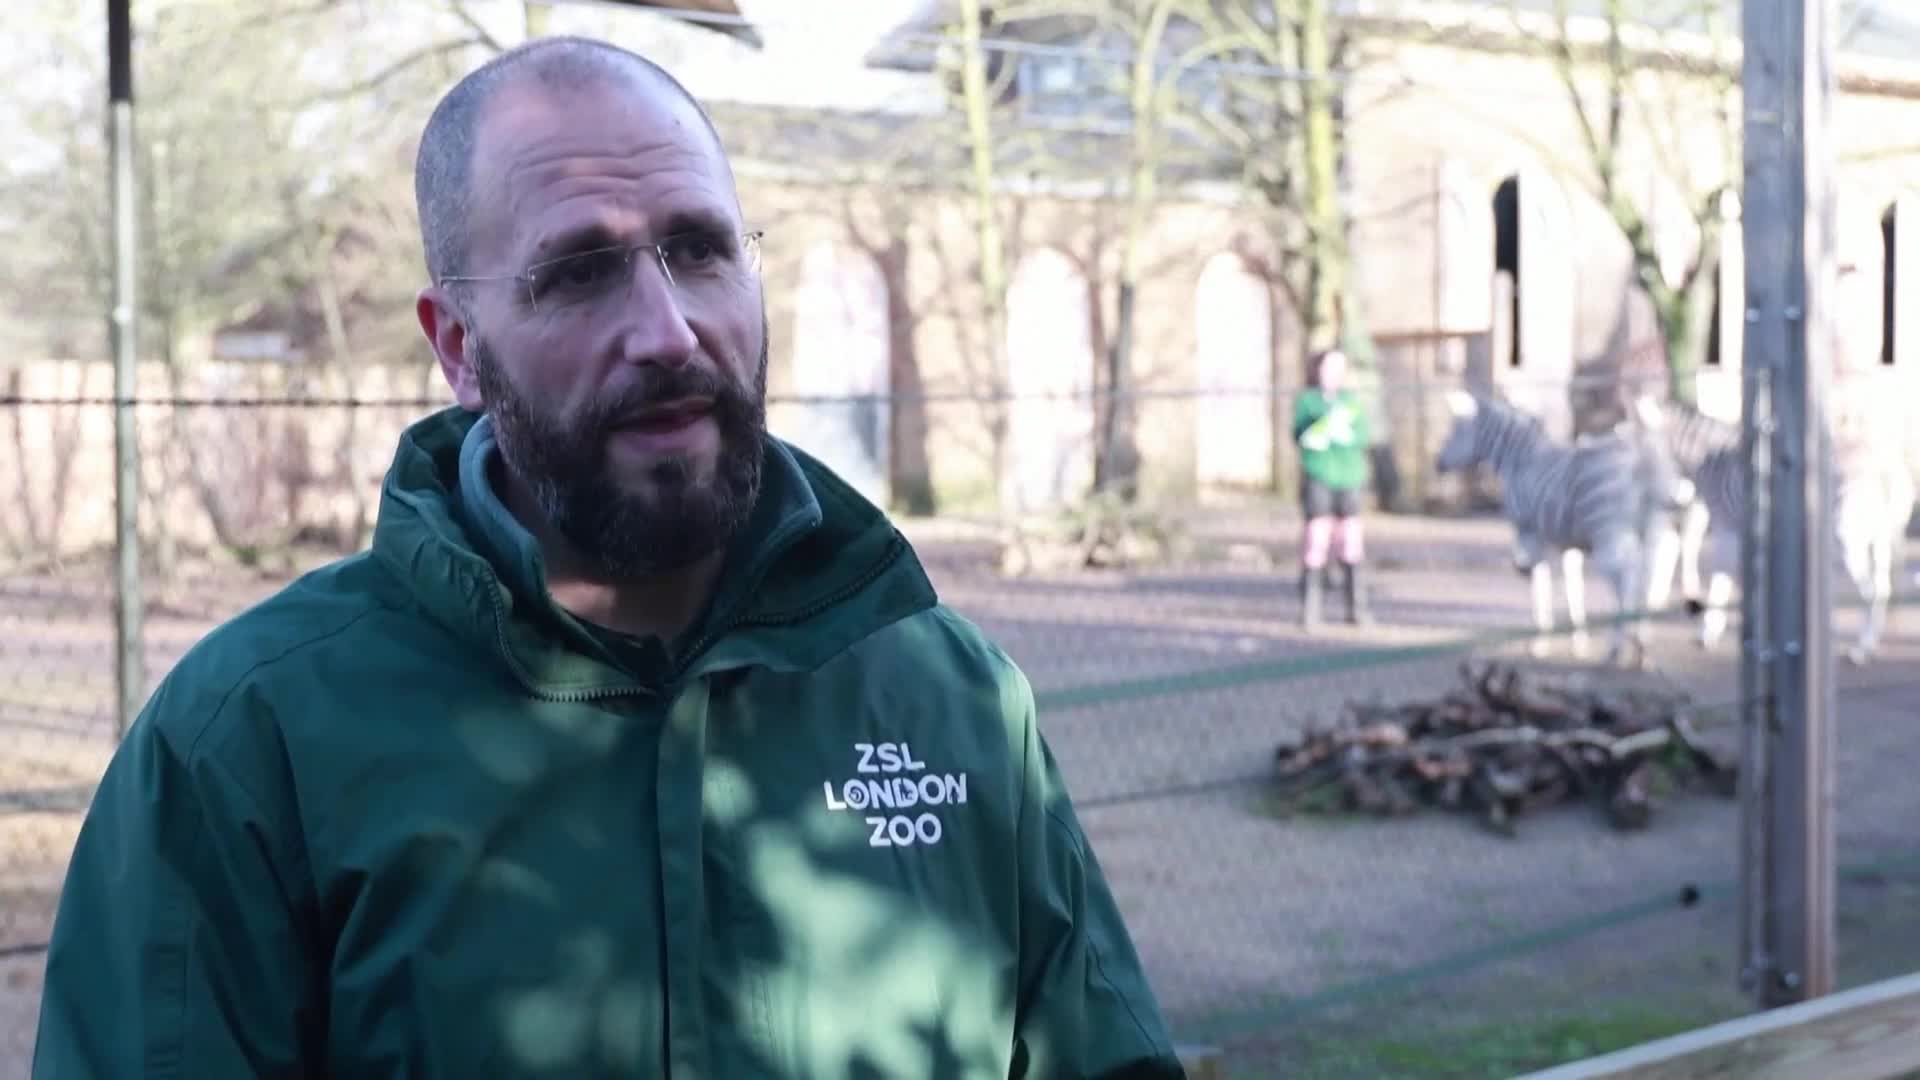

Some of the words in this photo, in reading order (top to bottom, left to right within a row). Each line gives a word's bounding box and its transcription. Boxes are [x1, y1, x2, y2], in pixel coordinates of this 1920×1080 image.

[854, 742, 926, 773] ZSL
[823, 773, 967, 811] LONDON
[865, 812, 942, 847] ZOO
